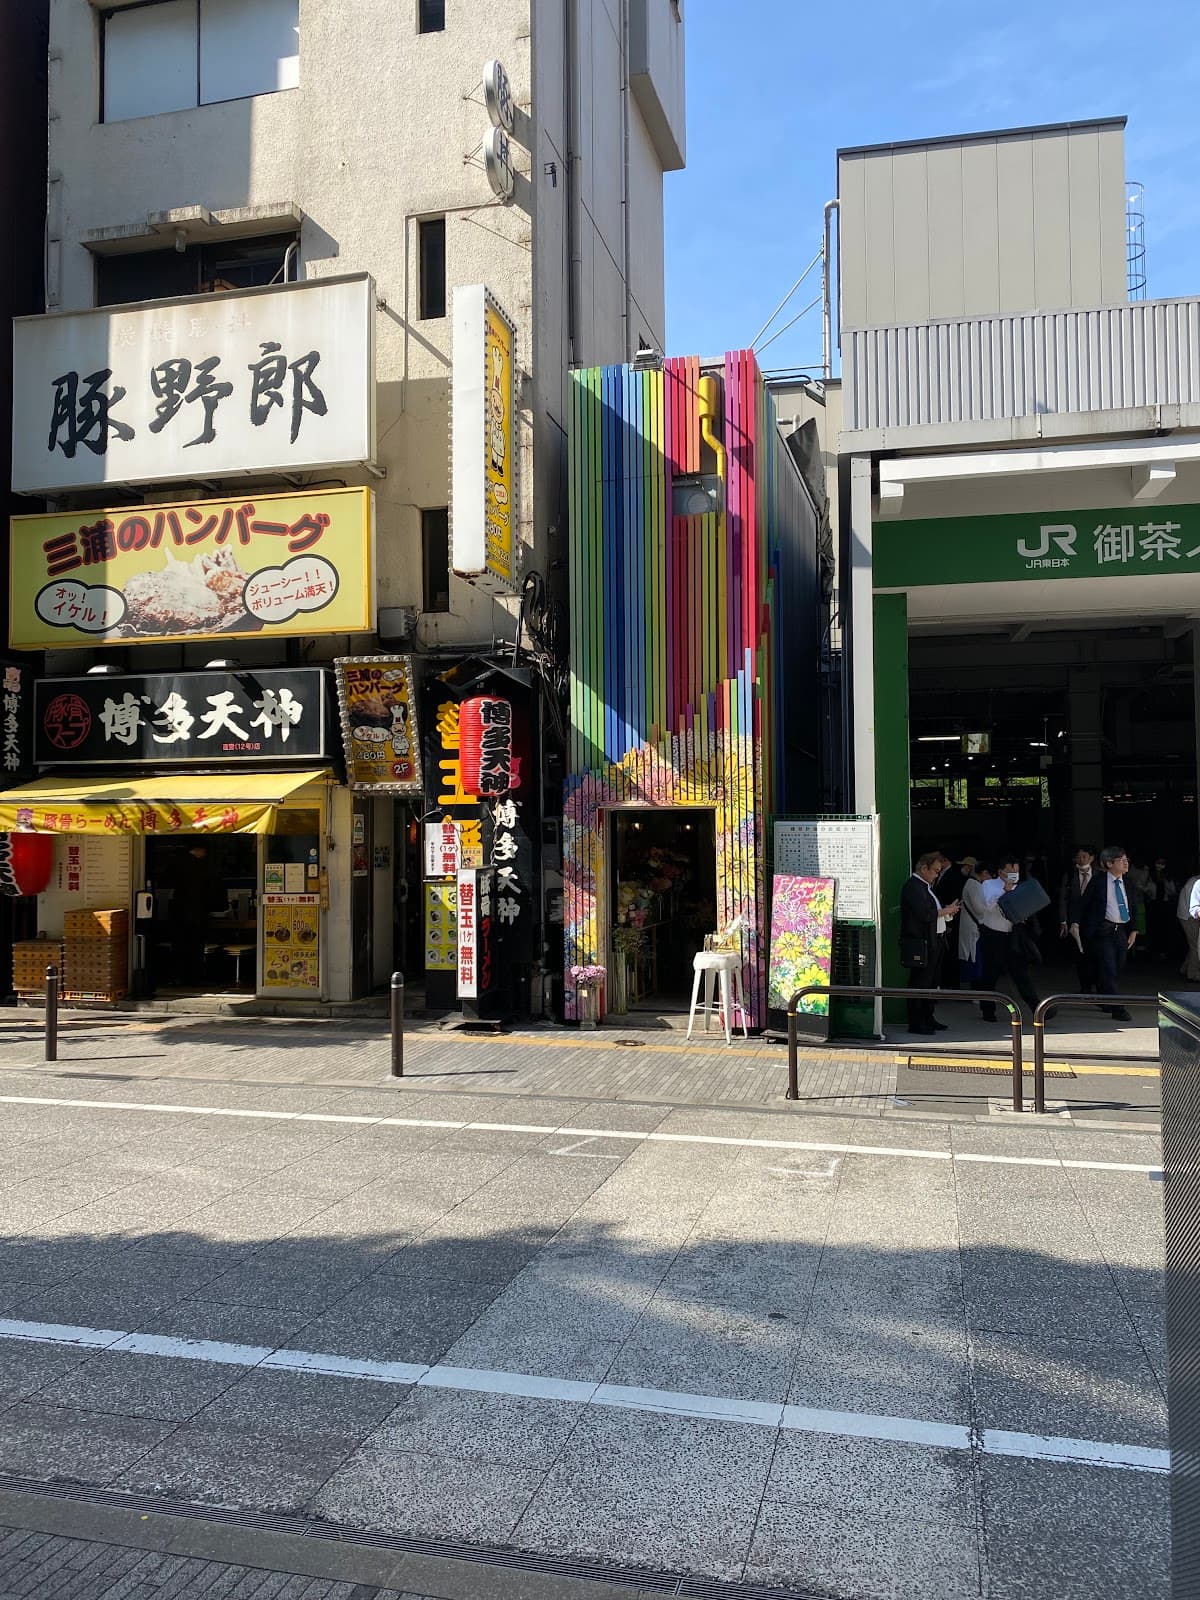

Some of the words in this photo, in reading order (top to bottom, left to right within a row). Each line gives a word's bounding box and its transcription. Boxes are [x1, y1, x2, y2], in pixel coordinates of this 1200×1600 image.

[48, 342, 328, 458] 豚野郎
[43, 504, 330, 576] 三浦のハンバーグ
[1016, 524, 1078, 558] JR
[1025, 557, 1071, 569] JR東日本
[53, 601, 107, 625] イケル!
[346, 668, 382, 683] 三浦の
[349, 682, 405, 696] ハンバーグ
[3, 693, 22, 771] 博多天神
[46, 717, 89, 746] スープ
[98, 688, 304, 746] 博多天神
[479, 700, 512, 795] 博多天神
[393, 763, 409, 774] 2F
[43, 812, 132, 831] 豚骨らーめん
[140, 807, 240, 832] 博多天神
[492, 798, 523, 926] 博多天神
